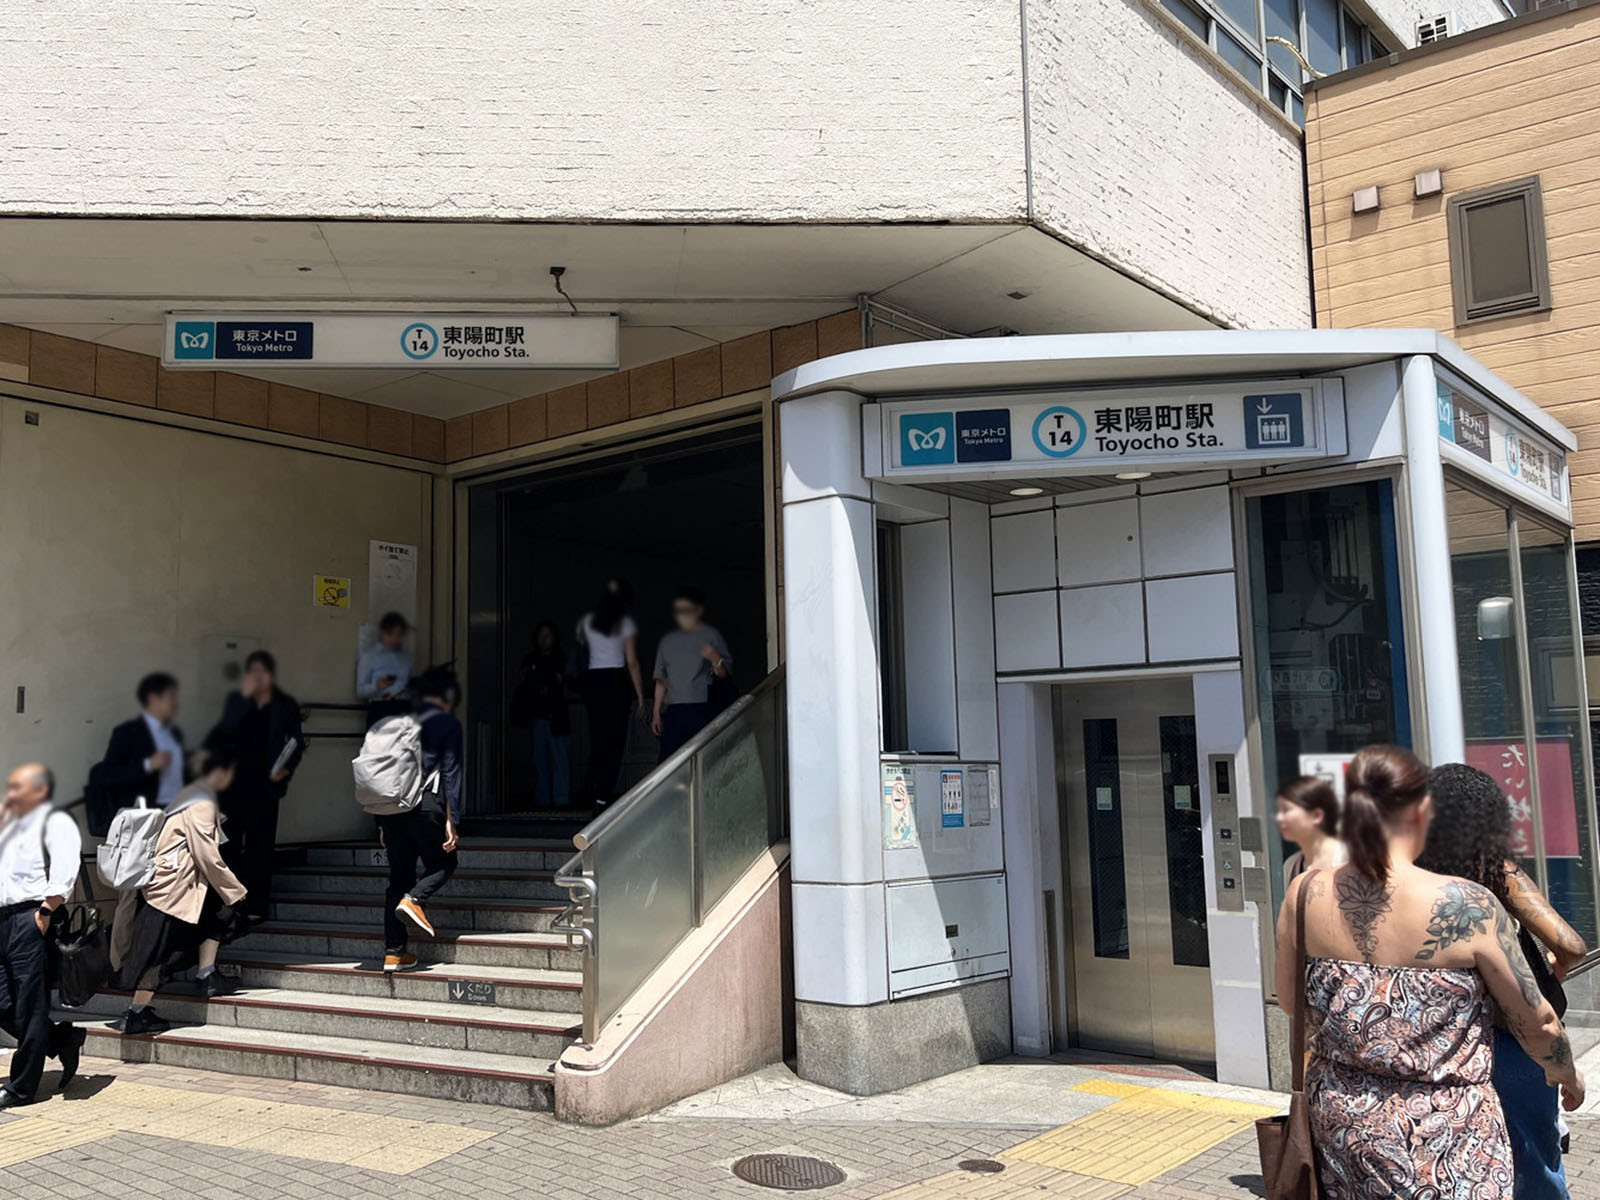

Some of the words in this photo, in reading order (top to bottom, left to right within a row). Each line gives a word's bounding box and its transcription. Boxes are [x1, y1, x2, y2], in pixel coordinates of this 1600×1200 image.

[232, 329, 297, 342] 東京メトロ
[415, 329, 423, 339] T
[442, 326, 525, 345] 東陽町駅
[236, 343, 263, 353] Tokyo
[265, 343, 293, 352] Metro
[411, 341, 429, 351] 14
[443, 346, 500, 360] Toyocho
[504, 346, 530, 358] Sta.
[1053, 415, 1064, 429] T
[1094, 403, 1215, 434] 東陽町駅
[961, 427, 1006, 438] 東京メトロ
[1049, 431, 1073, 446] 14
[964, 438, 982, 446] Tokyo
[1095, 433, 1180, 455] Toyocho
[1186, 432, 1224, 448] Sta.
